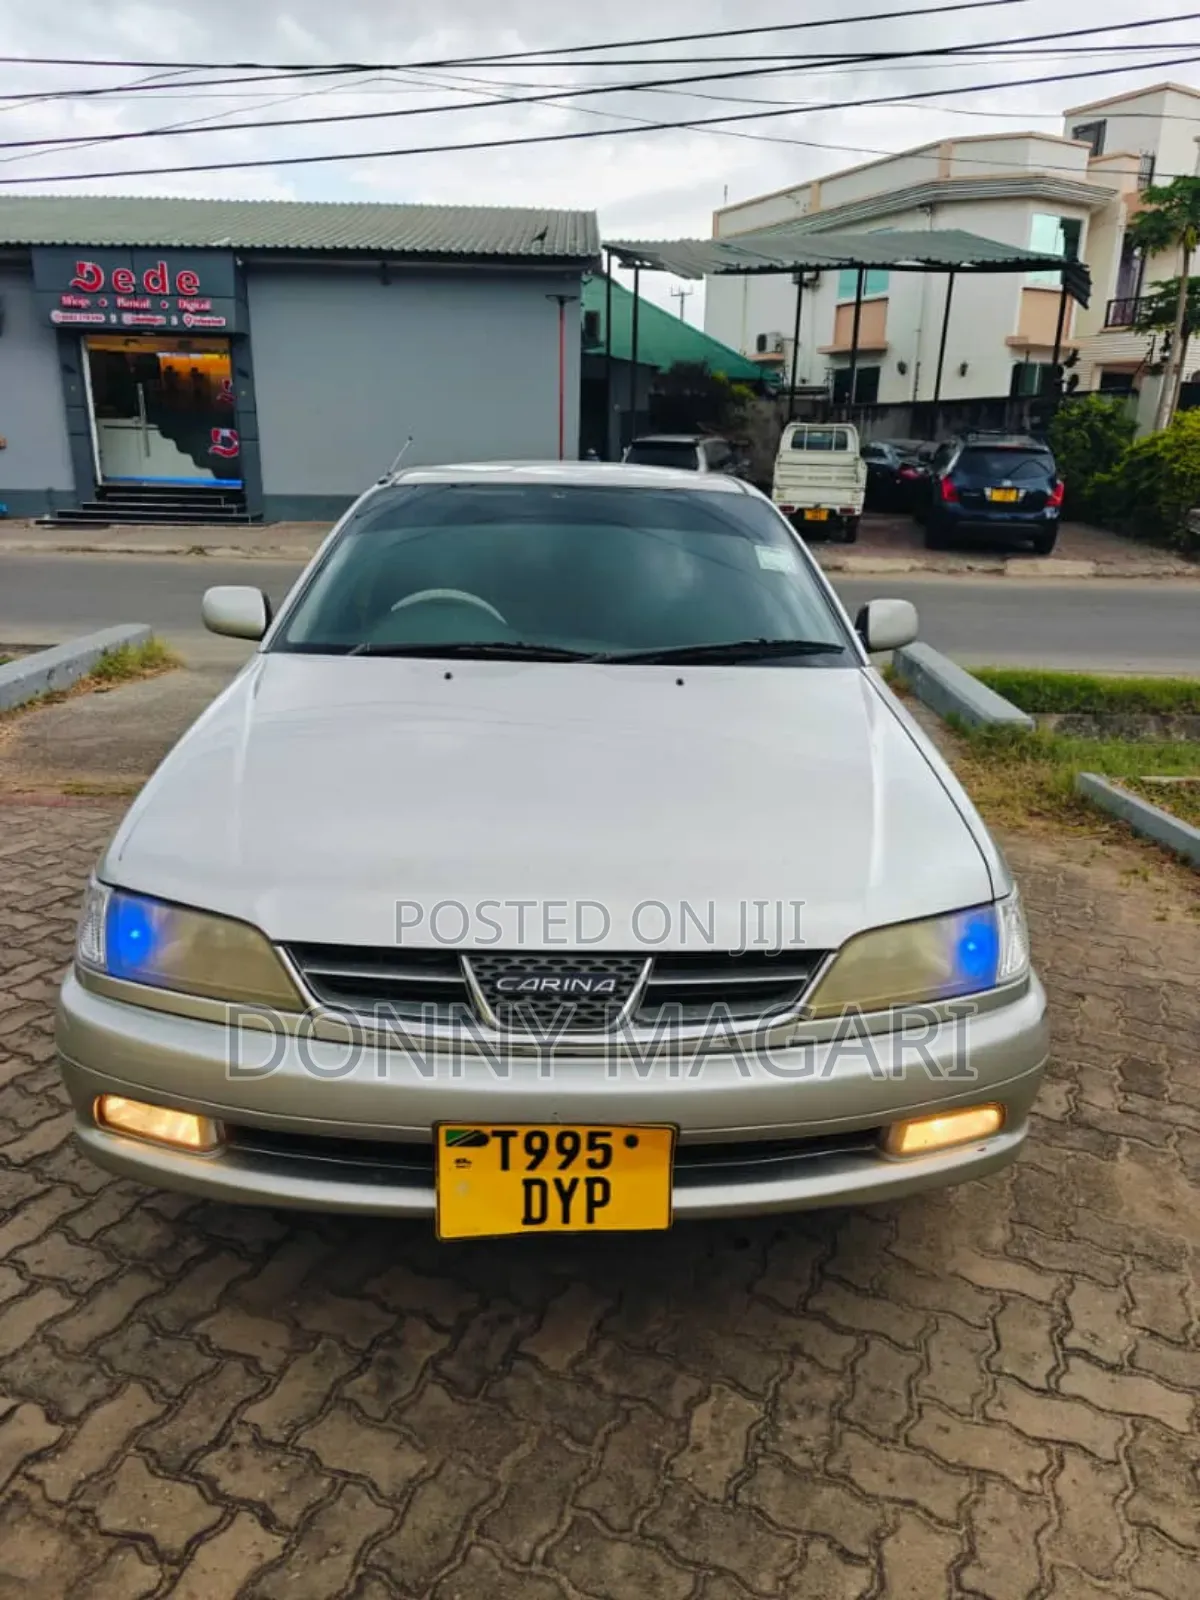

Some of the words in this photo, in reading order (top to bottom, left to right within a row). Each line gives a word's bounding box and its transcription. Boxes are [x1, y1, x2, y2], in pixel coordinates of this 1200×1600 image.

[69, 260, 200, 296] Dede
[496, 977, 616, 993] CARINA
[491, 1129, 613, 1172] T995
[521, 1176, 612, 1226] DYP
